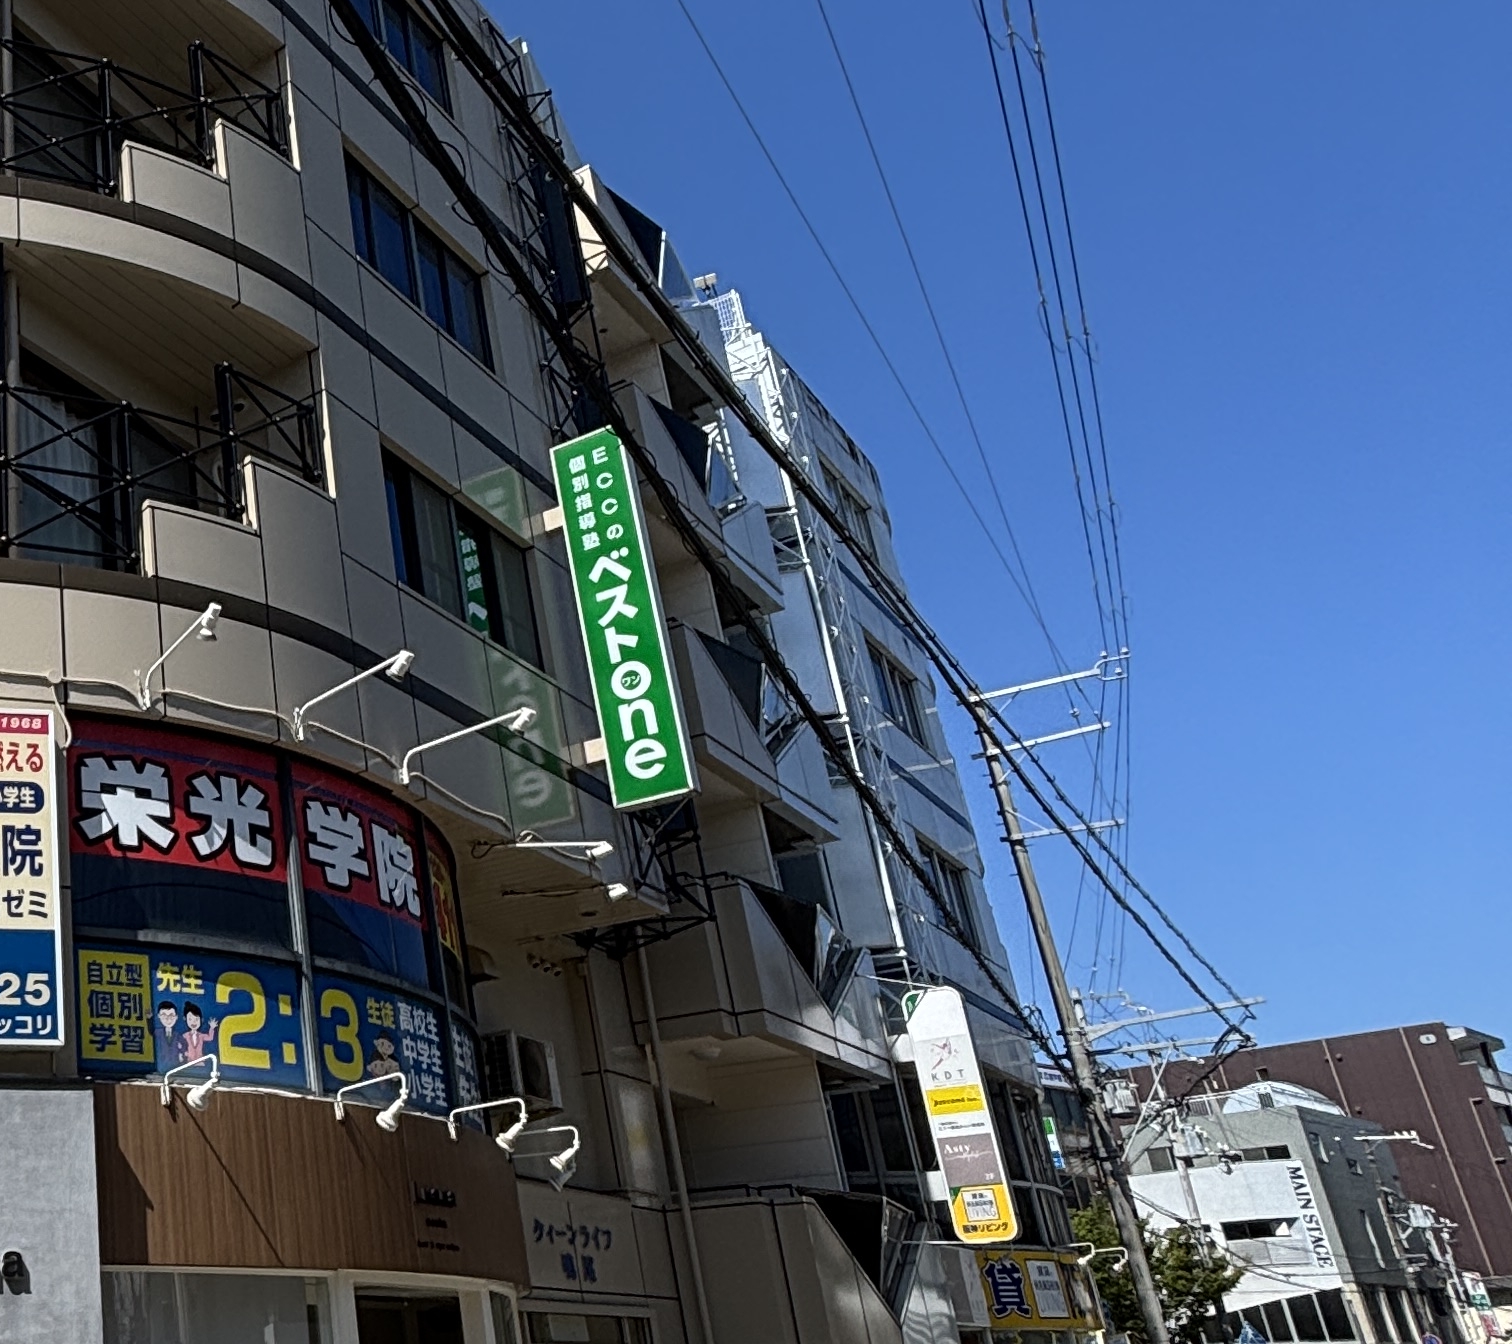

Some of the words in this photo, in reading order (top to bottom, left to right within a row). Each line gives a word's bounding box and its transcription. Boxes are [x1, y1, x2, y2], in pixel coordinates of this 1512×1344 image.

[568, 454, 601, 551] 個別指導塾
[591, 445, 624, 540] ECCの
[0, 716, 42, 729] 1968
[87, 960, 143, 989] 自立型
[87, 989, 144, 1021] 個別
[156, 962, 205, 995] 先生
[366, 996, 396, 1030] 生徒
[89, 1023, 145, 1055] 学習
[397, 1001, 439, 1042] 高校生
[402, 1037, 444, 1075] 中学生
[407, 1069, 448, 1108] 小学生
[944, 1144, 971, 1155] Asty
[1286, 1165, 1314, 1210] MAIN
